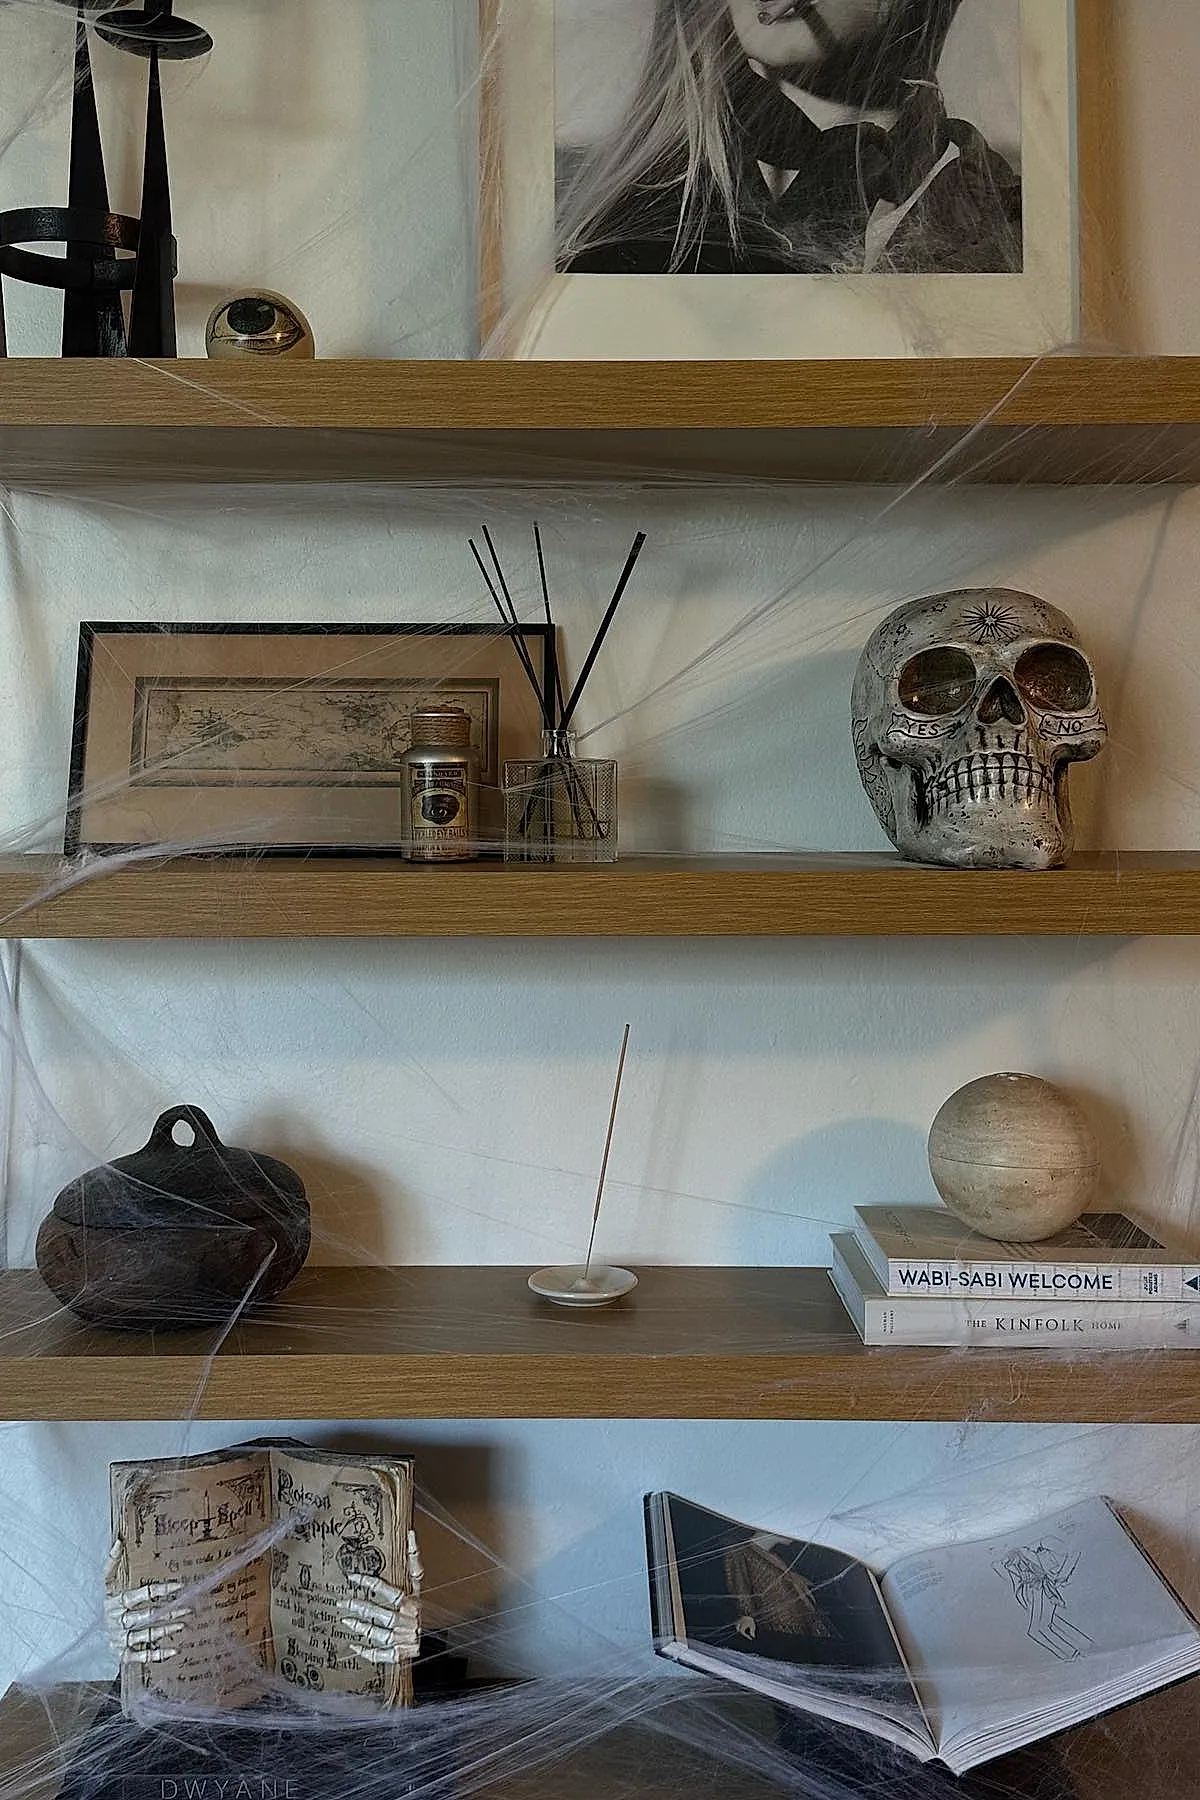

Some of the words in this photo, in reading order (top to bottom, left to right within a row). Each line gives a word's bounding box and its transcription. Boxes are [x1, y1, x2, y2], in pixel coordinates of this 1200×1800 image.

[905, 719, 940, 735] YES
[1056, 719, 1083, 734] NO
[899, 1269, 1002, 1288] WABI-SABI
[1008, 1272, 1113, 1290] WELCOME
[966, 1319, 987, 1328] THE
[995, 1317, 1084, 1332] KINFOLK
[277, 1467, 331, 1510] Poison
[161, 1779, 299, 1799] DWYANE
